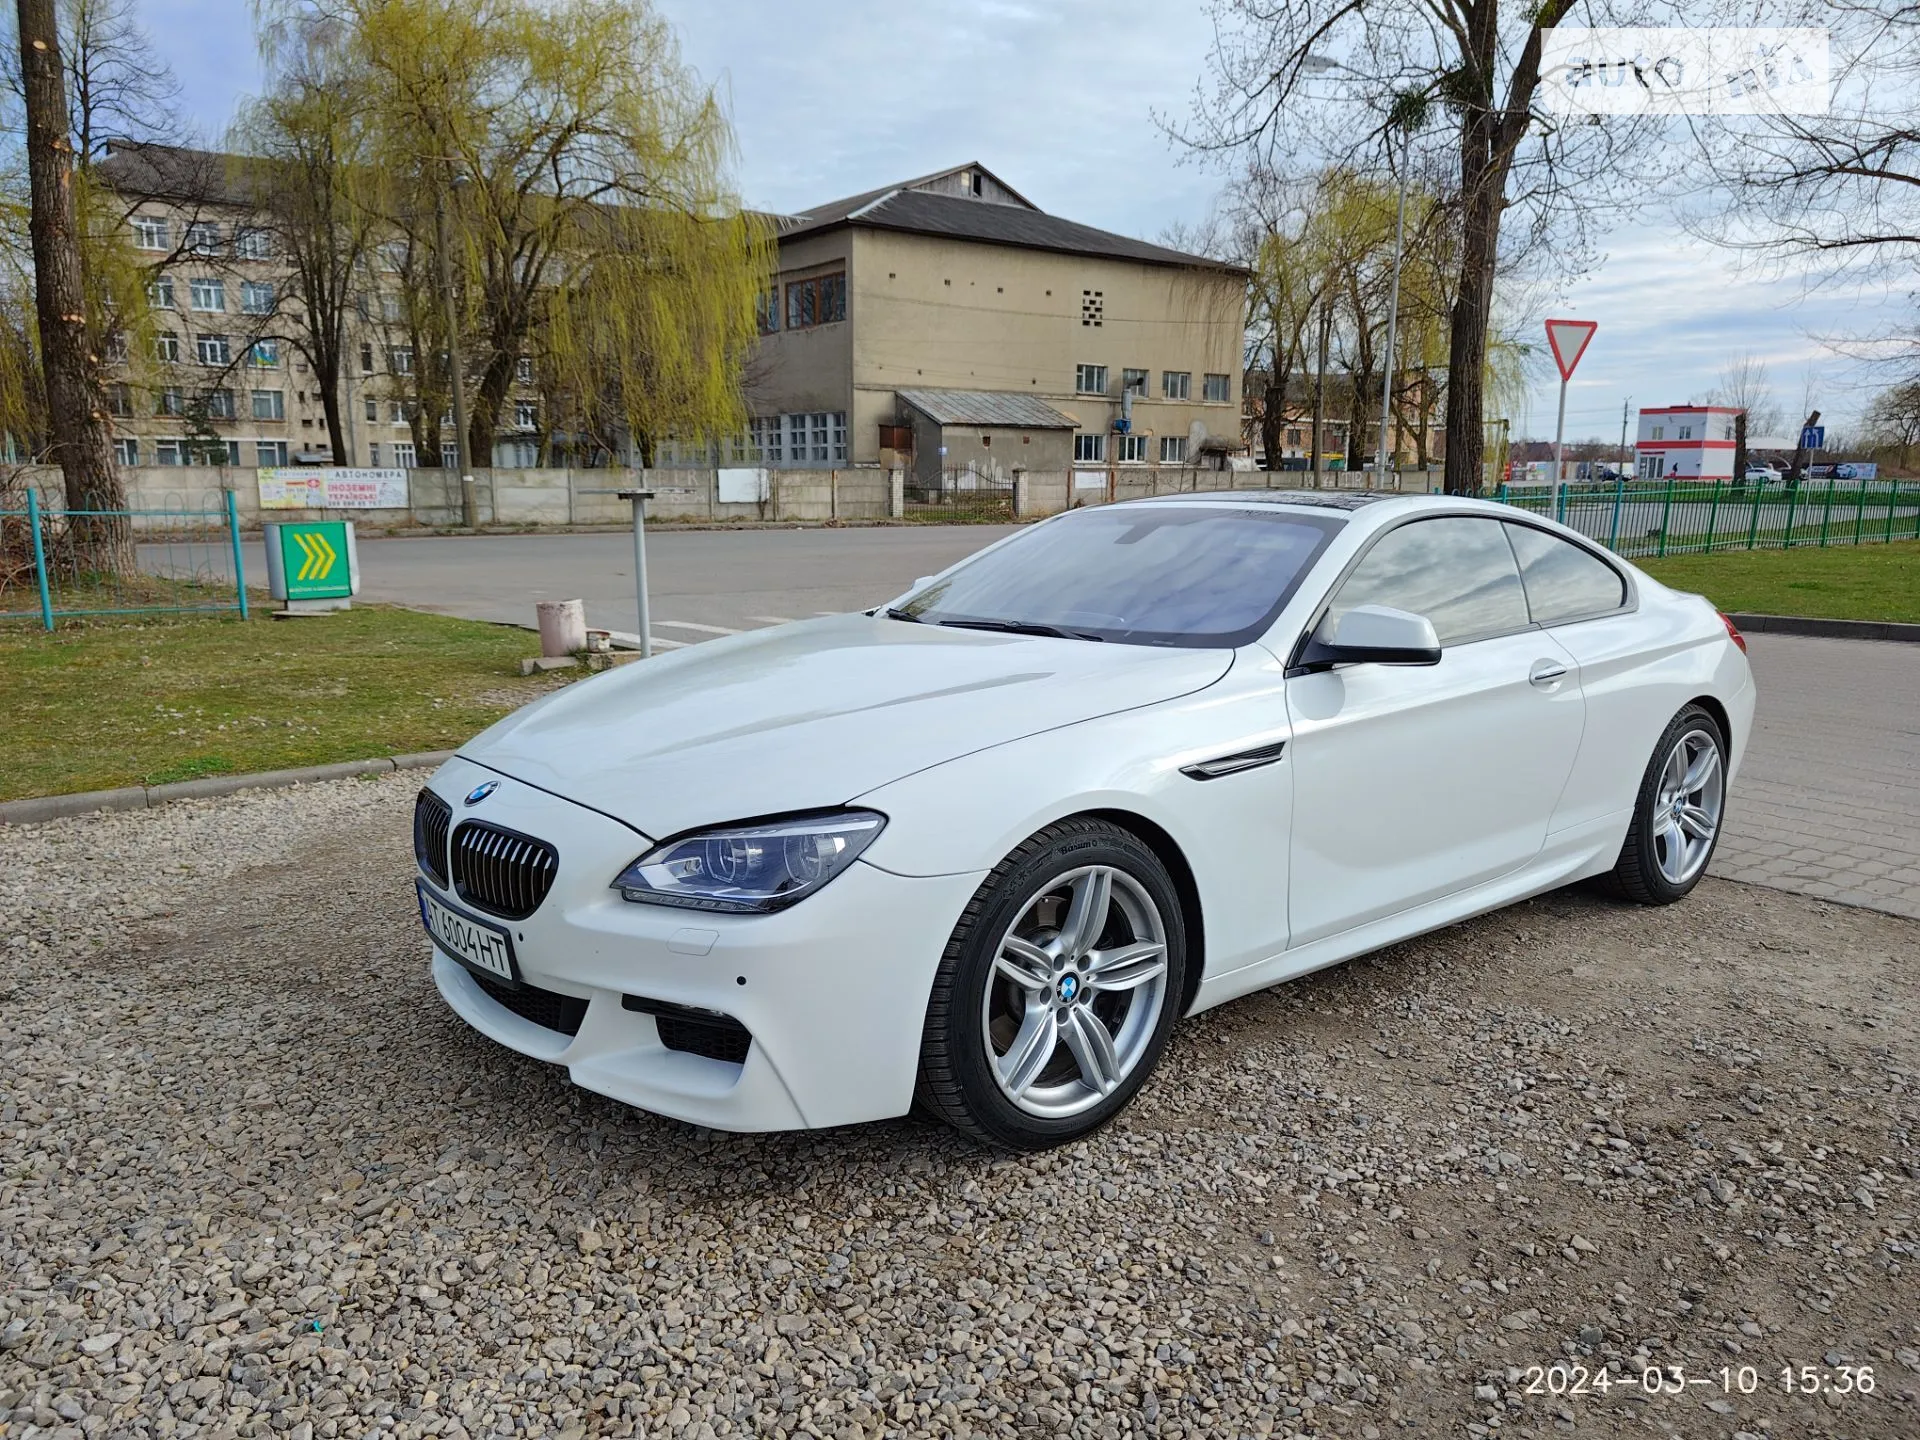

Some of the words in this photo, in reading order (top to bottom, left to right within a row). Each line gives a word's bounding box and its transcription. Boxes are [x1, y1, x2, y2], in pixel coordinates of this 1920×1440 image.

[335, 471, 402, 479] АВТОНОМЕРА
[442, 911, 478, 960] 6004
[476, 930, 505, 972] HT
